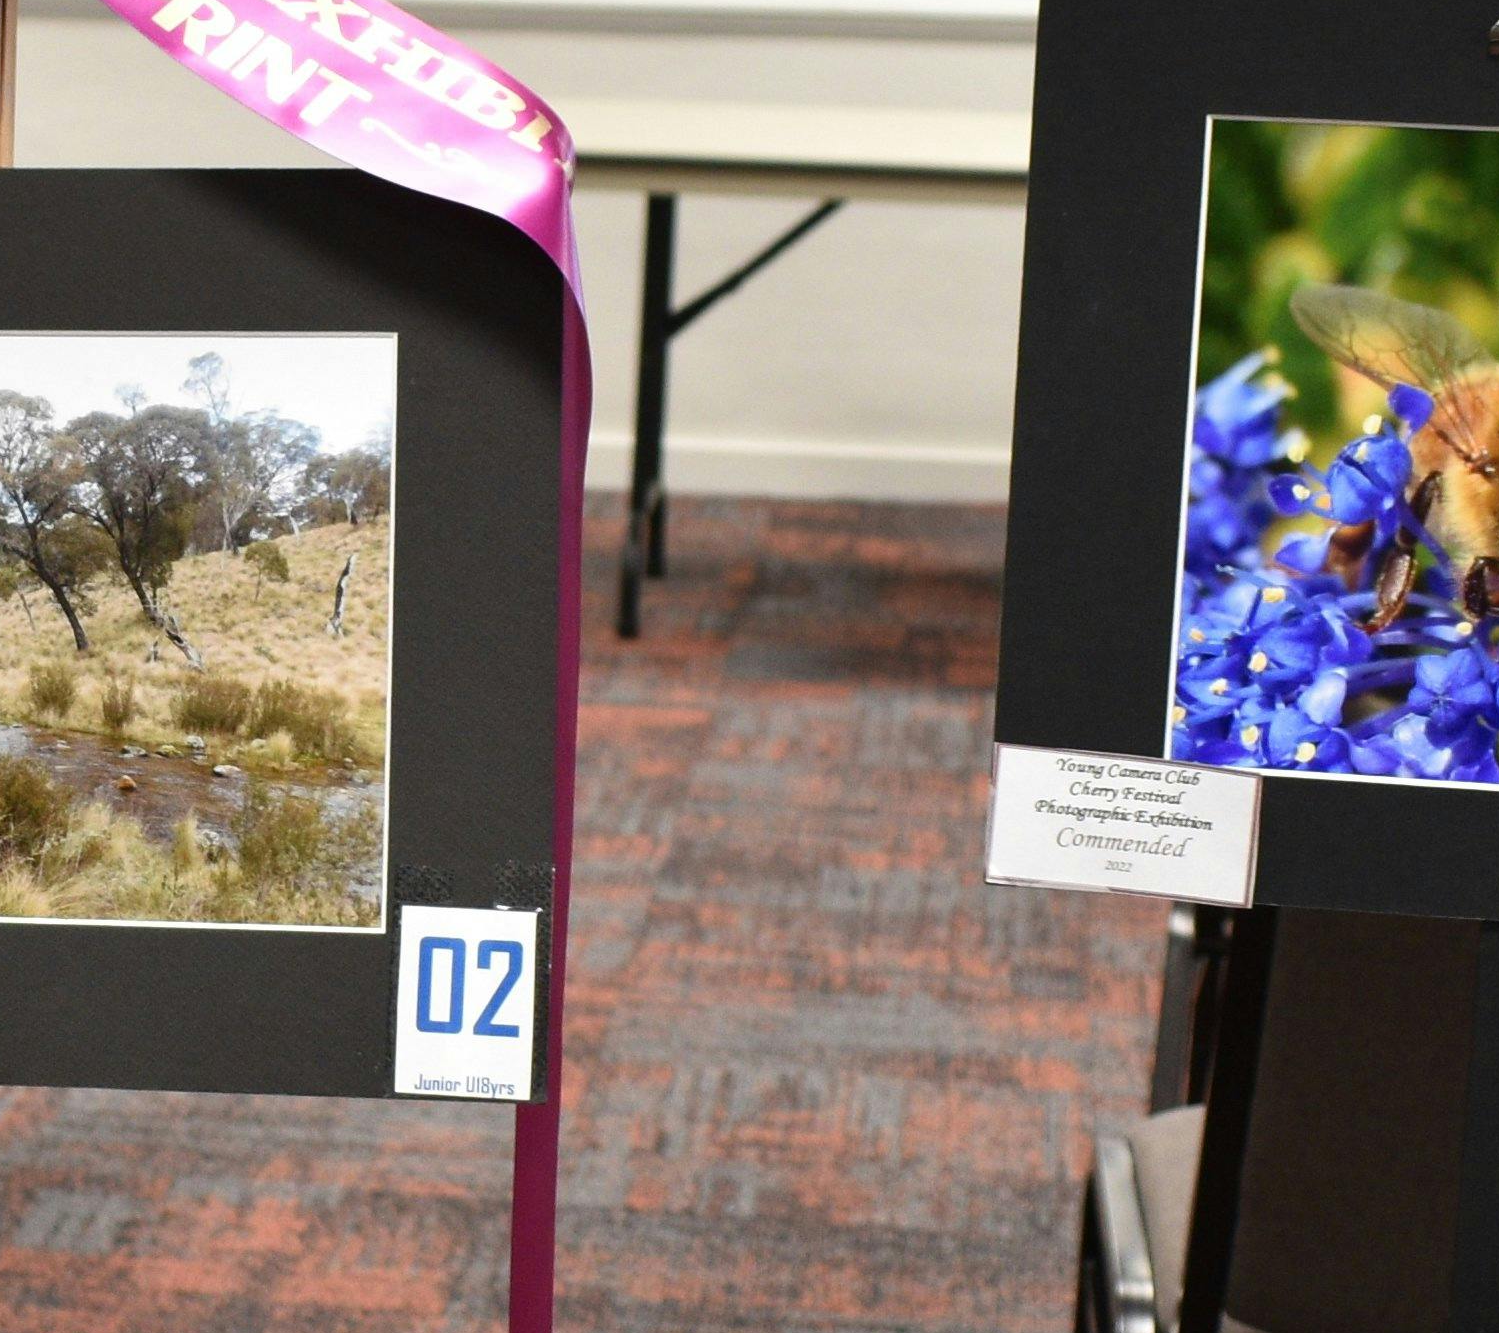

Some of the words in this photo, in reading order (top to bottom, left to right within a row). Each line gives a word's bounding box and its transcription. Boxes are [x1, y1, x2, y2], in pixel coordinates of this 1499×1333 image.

[1056, 757, 1105, 779] Young
[1107, 763, 1162, 782] Camera
[1164, 770, 1201, 786] Club
[1068, 781, 1119, 802] Cherry
[1121, 787, 1187, 806] Festival
[1034, 799, 1133, 825] Photographic
[1134, 810, 1214, 832] Exhibition
[1055, 827, 1194, 858] Commended
[1104, 860, 1133, 873] 2022
[416, 935, 524, 1038] 02
[413, 1073, 462, 1093] Junior
[465, 1075, 516, 1098] U18yrs
